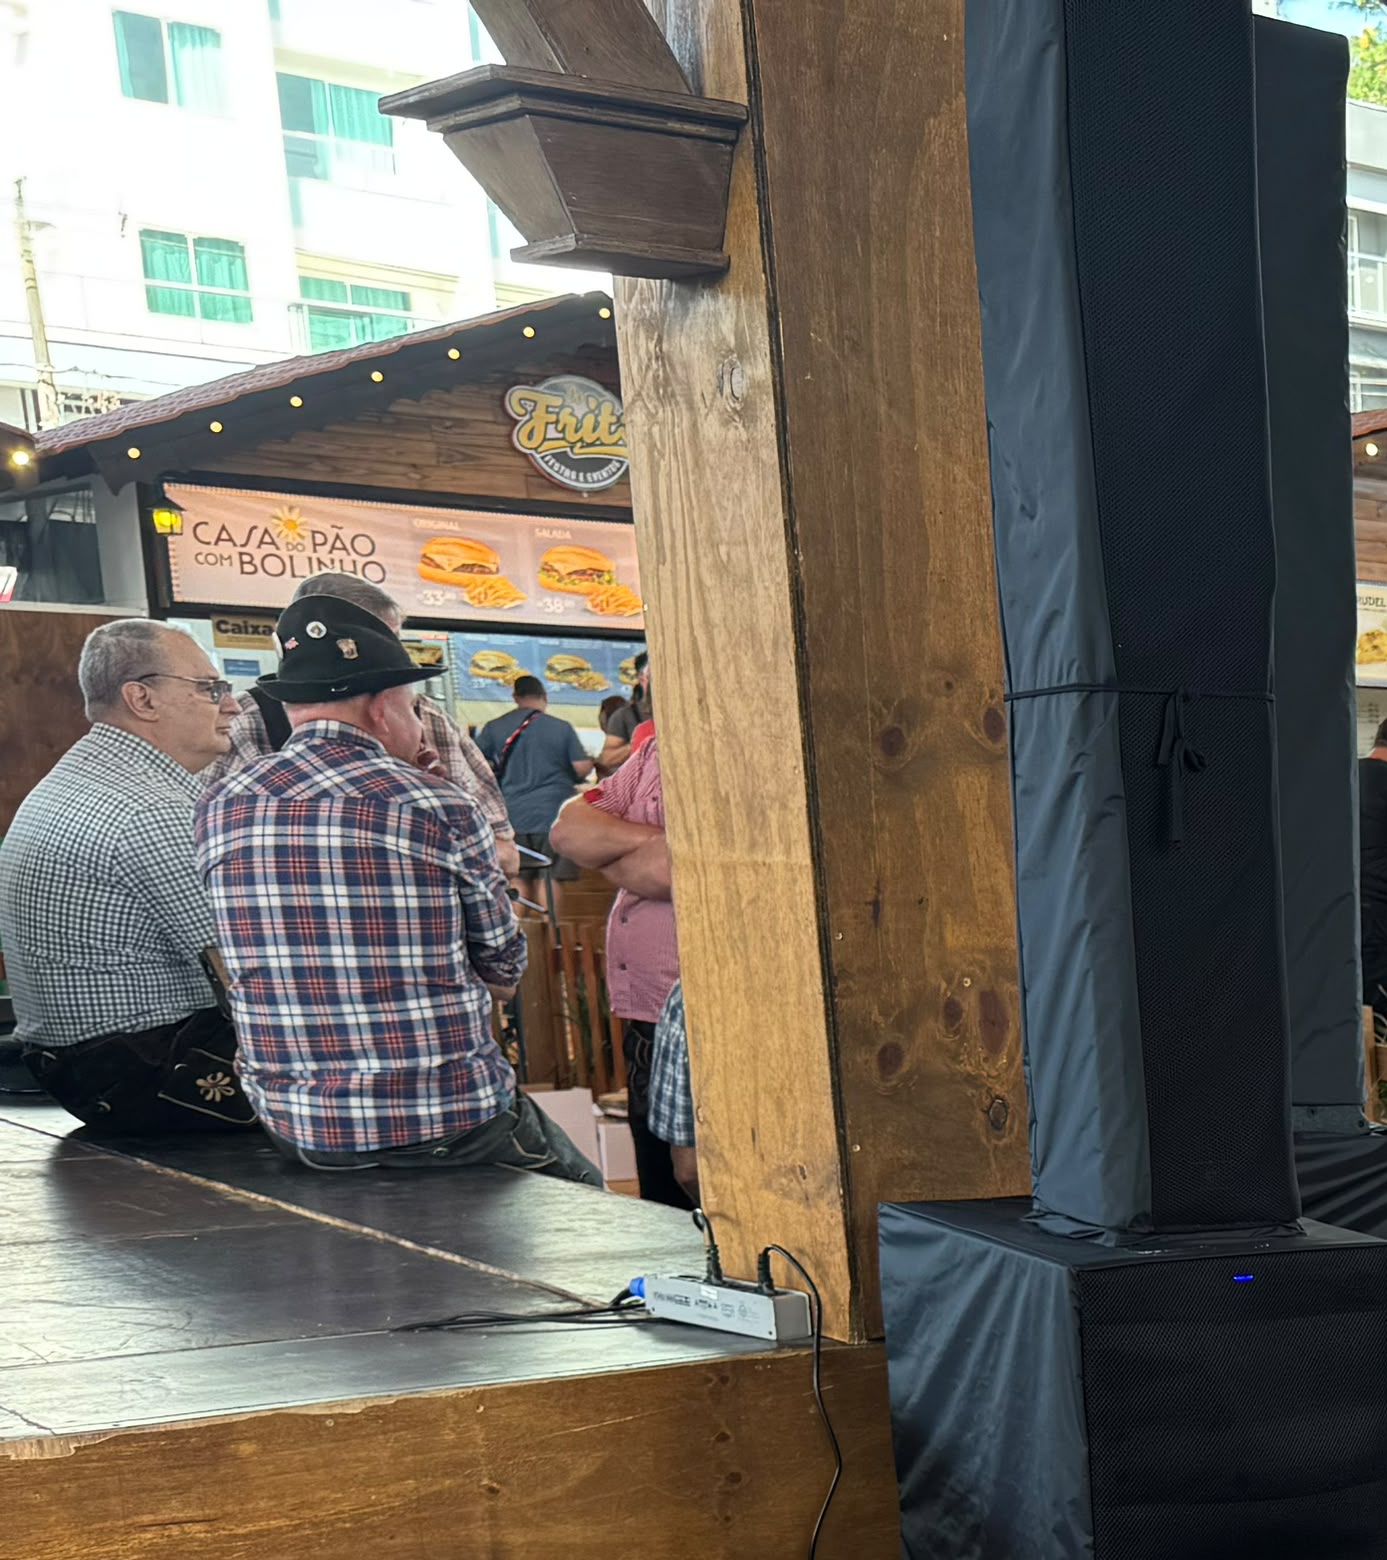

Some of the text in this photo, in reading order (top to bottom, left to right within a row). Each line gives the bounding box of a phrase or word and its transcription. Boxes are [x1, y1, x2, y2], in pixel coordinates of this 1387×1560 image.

[192, 521, 376, 557] CASA DO PÃO
[194, 551, 386, 584] COM BOLINHO
[215, 619, 274, 635] Caixa
